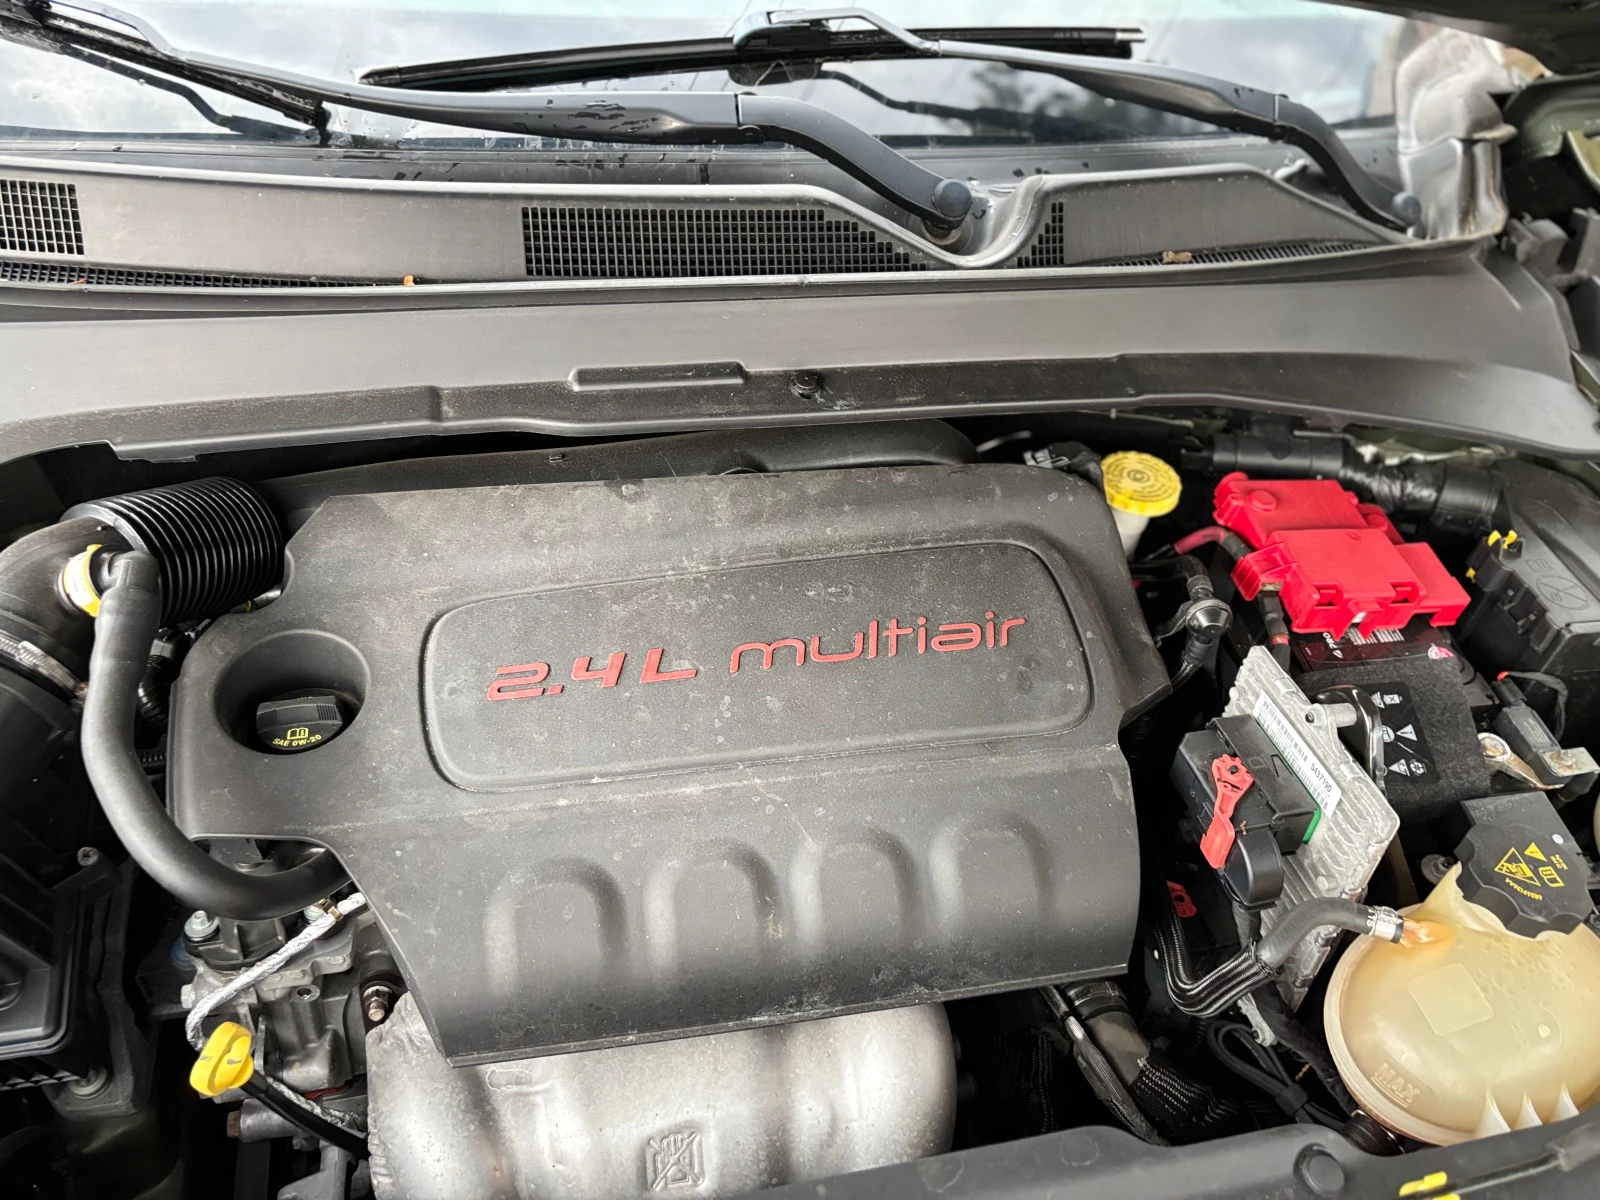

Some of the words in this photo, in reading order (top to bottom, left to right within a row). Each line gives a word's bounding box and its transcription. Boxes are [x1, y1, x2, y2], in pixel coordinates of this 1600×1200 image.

[728, 610, 1027, 674] multiair
[272, 738, 290, 747] SAE
[292, 734, 322, 747] 0W-20
[1373, 1062, 1420, 1103] MAX
